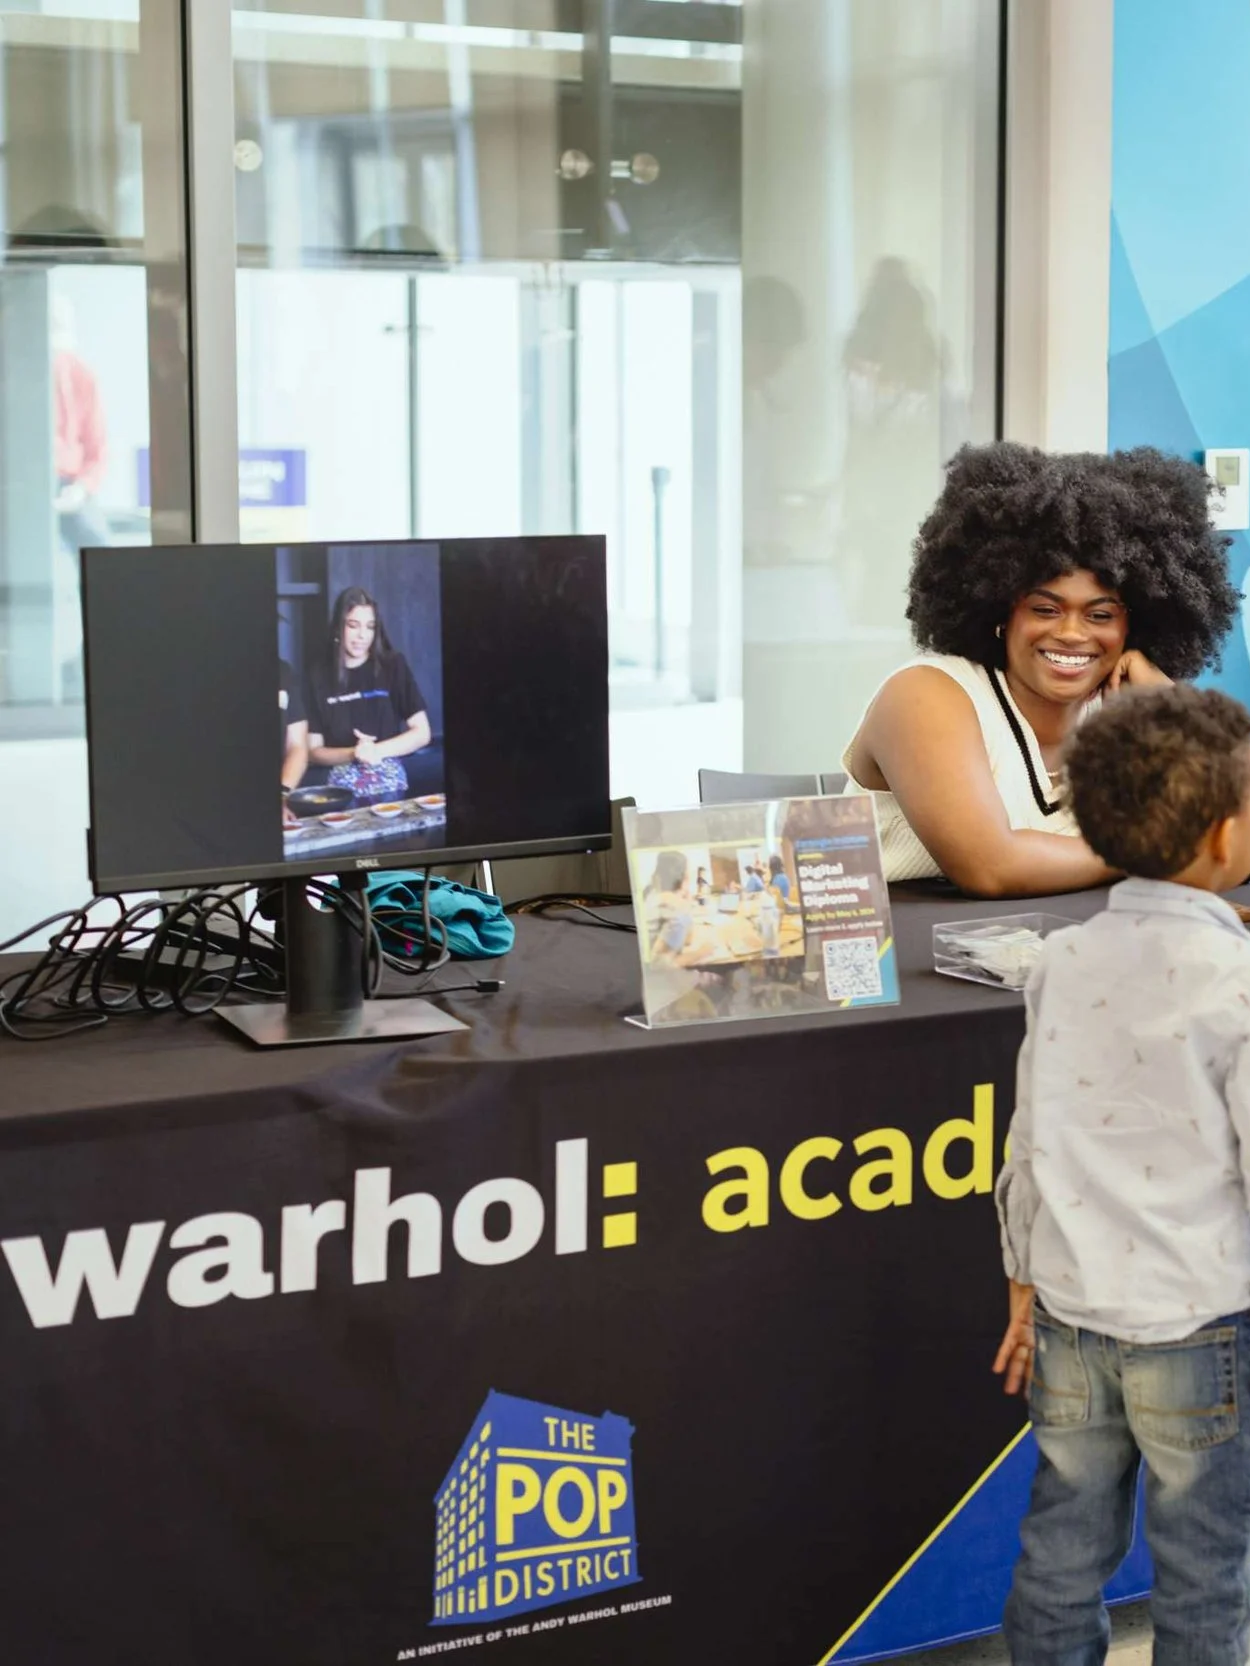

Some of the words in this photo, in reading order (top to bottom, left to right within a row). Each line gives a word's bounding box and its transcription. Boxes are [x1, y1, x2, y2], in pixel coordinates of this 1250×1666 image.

[356, 858, 379, 868] DELL
[799, 863, 843, 879] Digital
[803, 893, 858, 908] Diploma
[0, 1137, 637, 1328] warhol:
[702, 1083, 1012, 1233] acad
[544, 1417, 595, 1450] THE
[496, 1463, 627, 1545] POP
[494, 1550, 632, 1607] DISTRICT
[397, 1650, 416, 1660] AN
[418, 1634, 484, 1656] INITIATIVE
[485, 1630, 503, 1642] OF
[505, 1624, 530, 1638] THE
[532, 1617, 565, 1632] ANDY
[567, 1607, 618, 1625] WARHOL
[620, 1595, 672, 1614] MUSEUM
